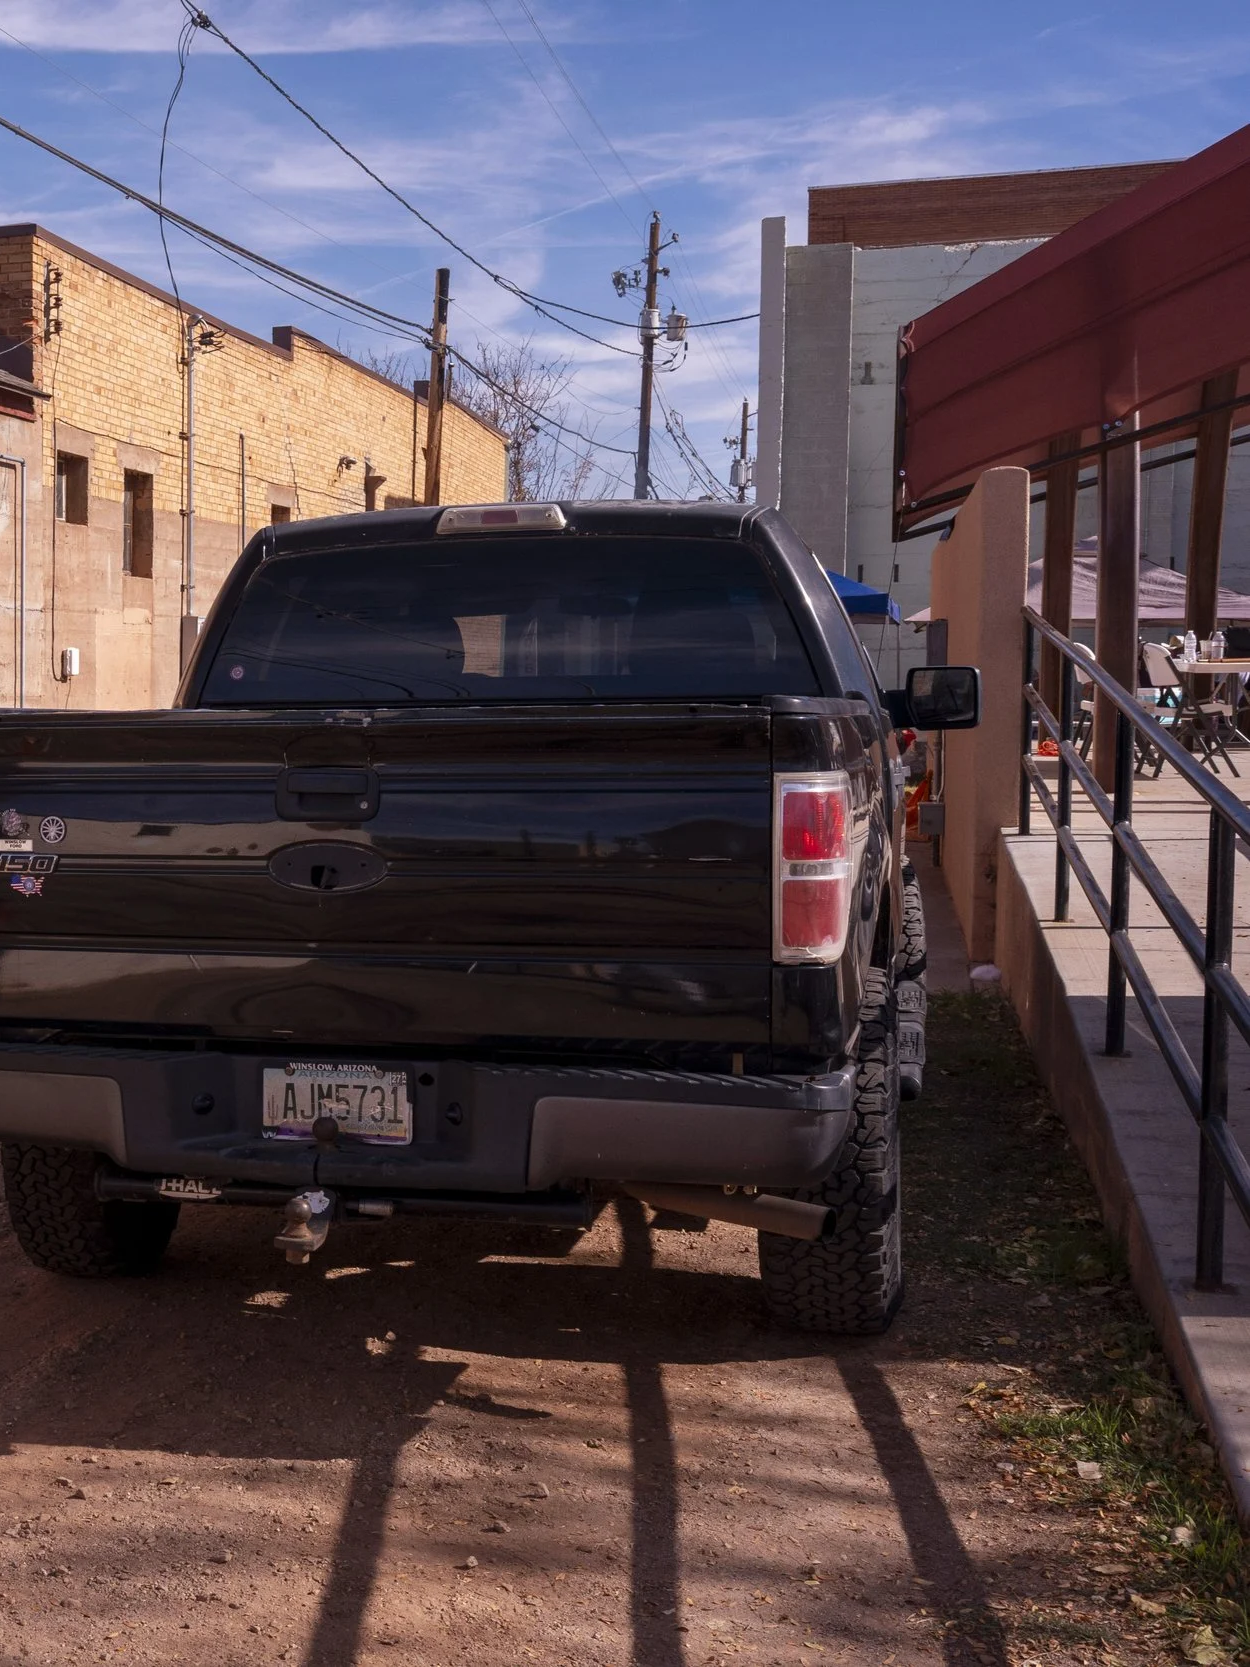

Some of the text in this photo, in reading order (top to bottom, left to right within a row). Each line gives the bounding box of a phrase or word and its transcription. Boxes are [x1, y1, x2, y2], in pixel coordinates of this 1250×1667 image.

[337, 1064, 377, 1072] ARIZONA
[298, 1070, 373, 1079] ARIZONA
[283, 1082, 403, 1124] AJM5731
